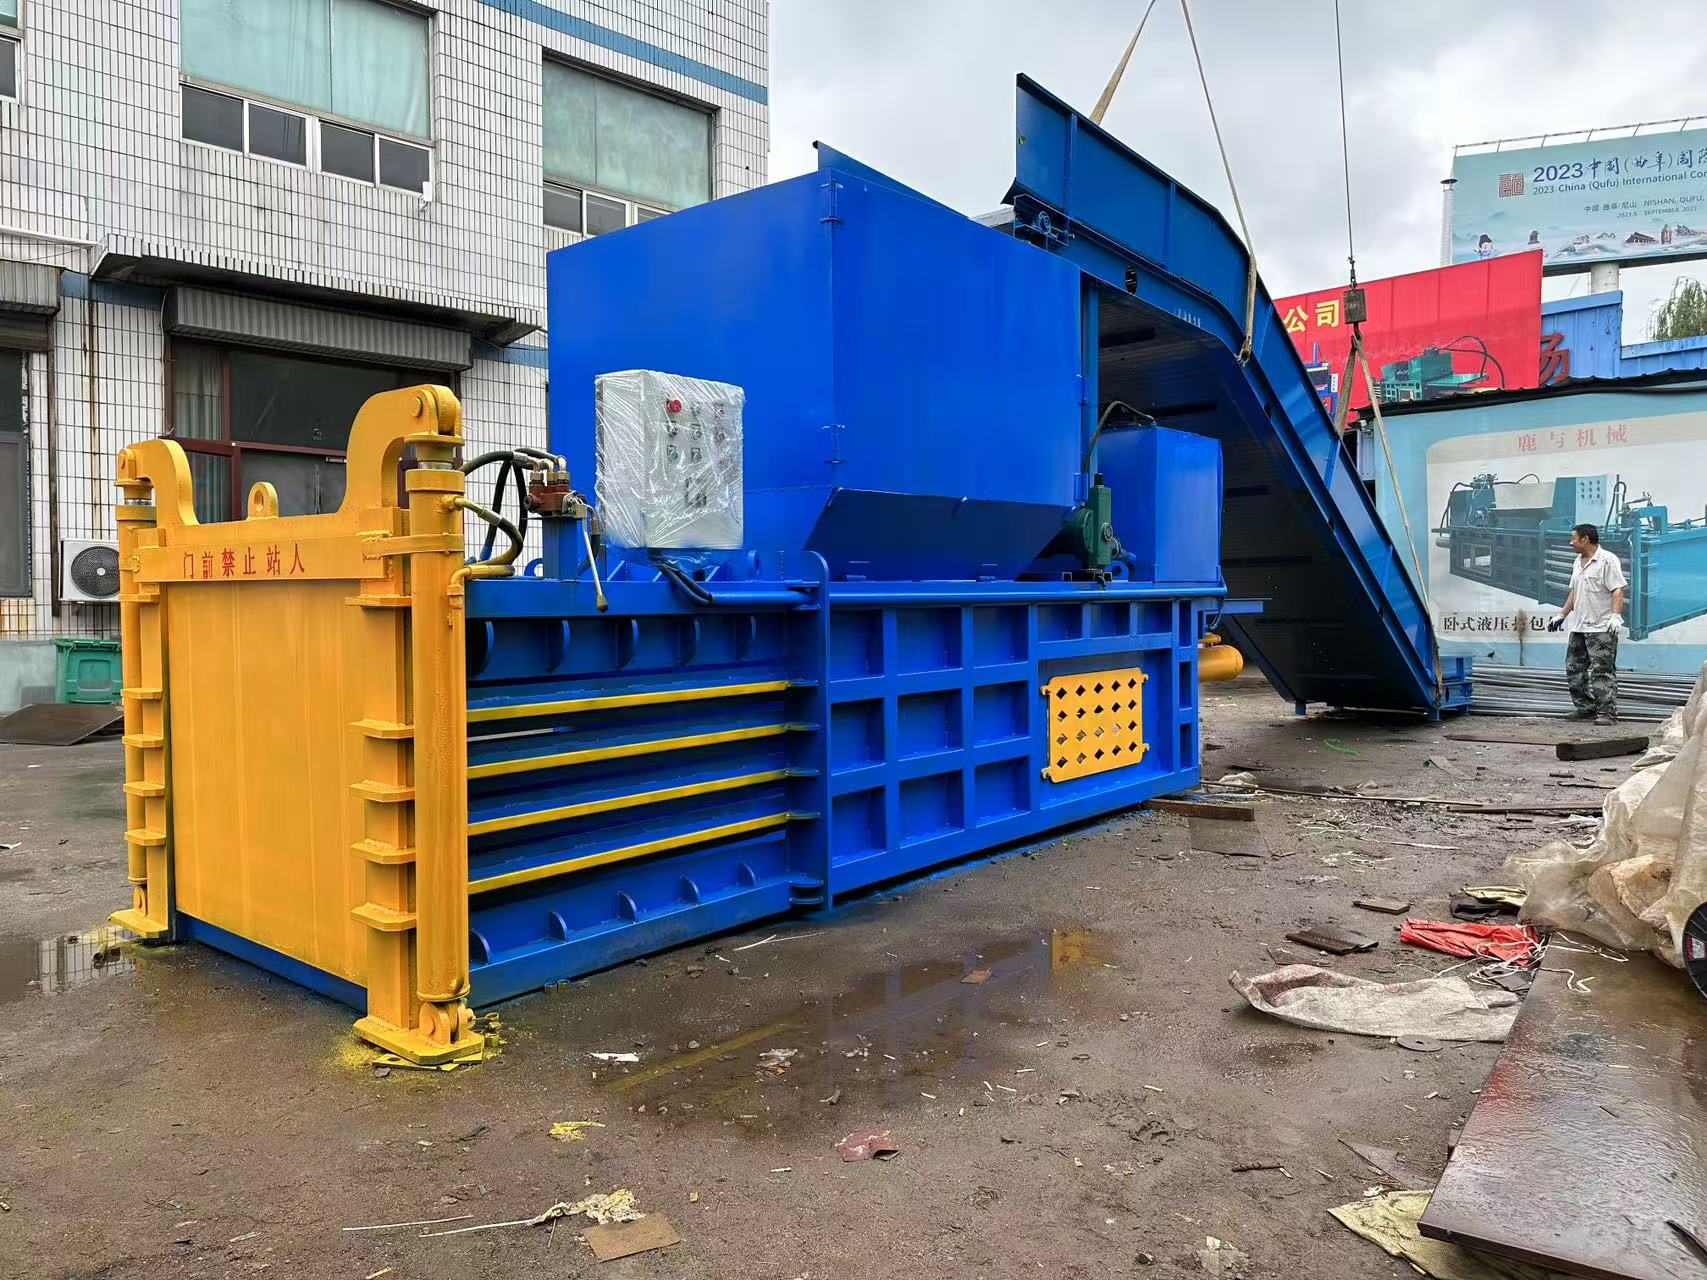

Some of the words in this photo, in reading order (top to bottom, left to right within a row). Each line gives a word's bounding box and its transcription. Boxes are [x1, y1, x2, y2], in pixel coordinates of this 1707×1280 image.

[1533, 186, 1555, 196] 2023
[1558, 183, 1585, 193] China
[1589, 178, 1619, 191] (Qufu)
[1622, 171, 1687, 186] International
[1283, 299, 1340, 333] 公司
[183, 543, 305, 580] 门前禁止站人
[1444, 616, 1565, 633] 卧式液压包
